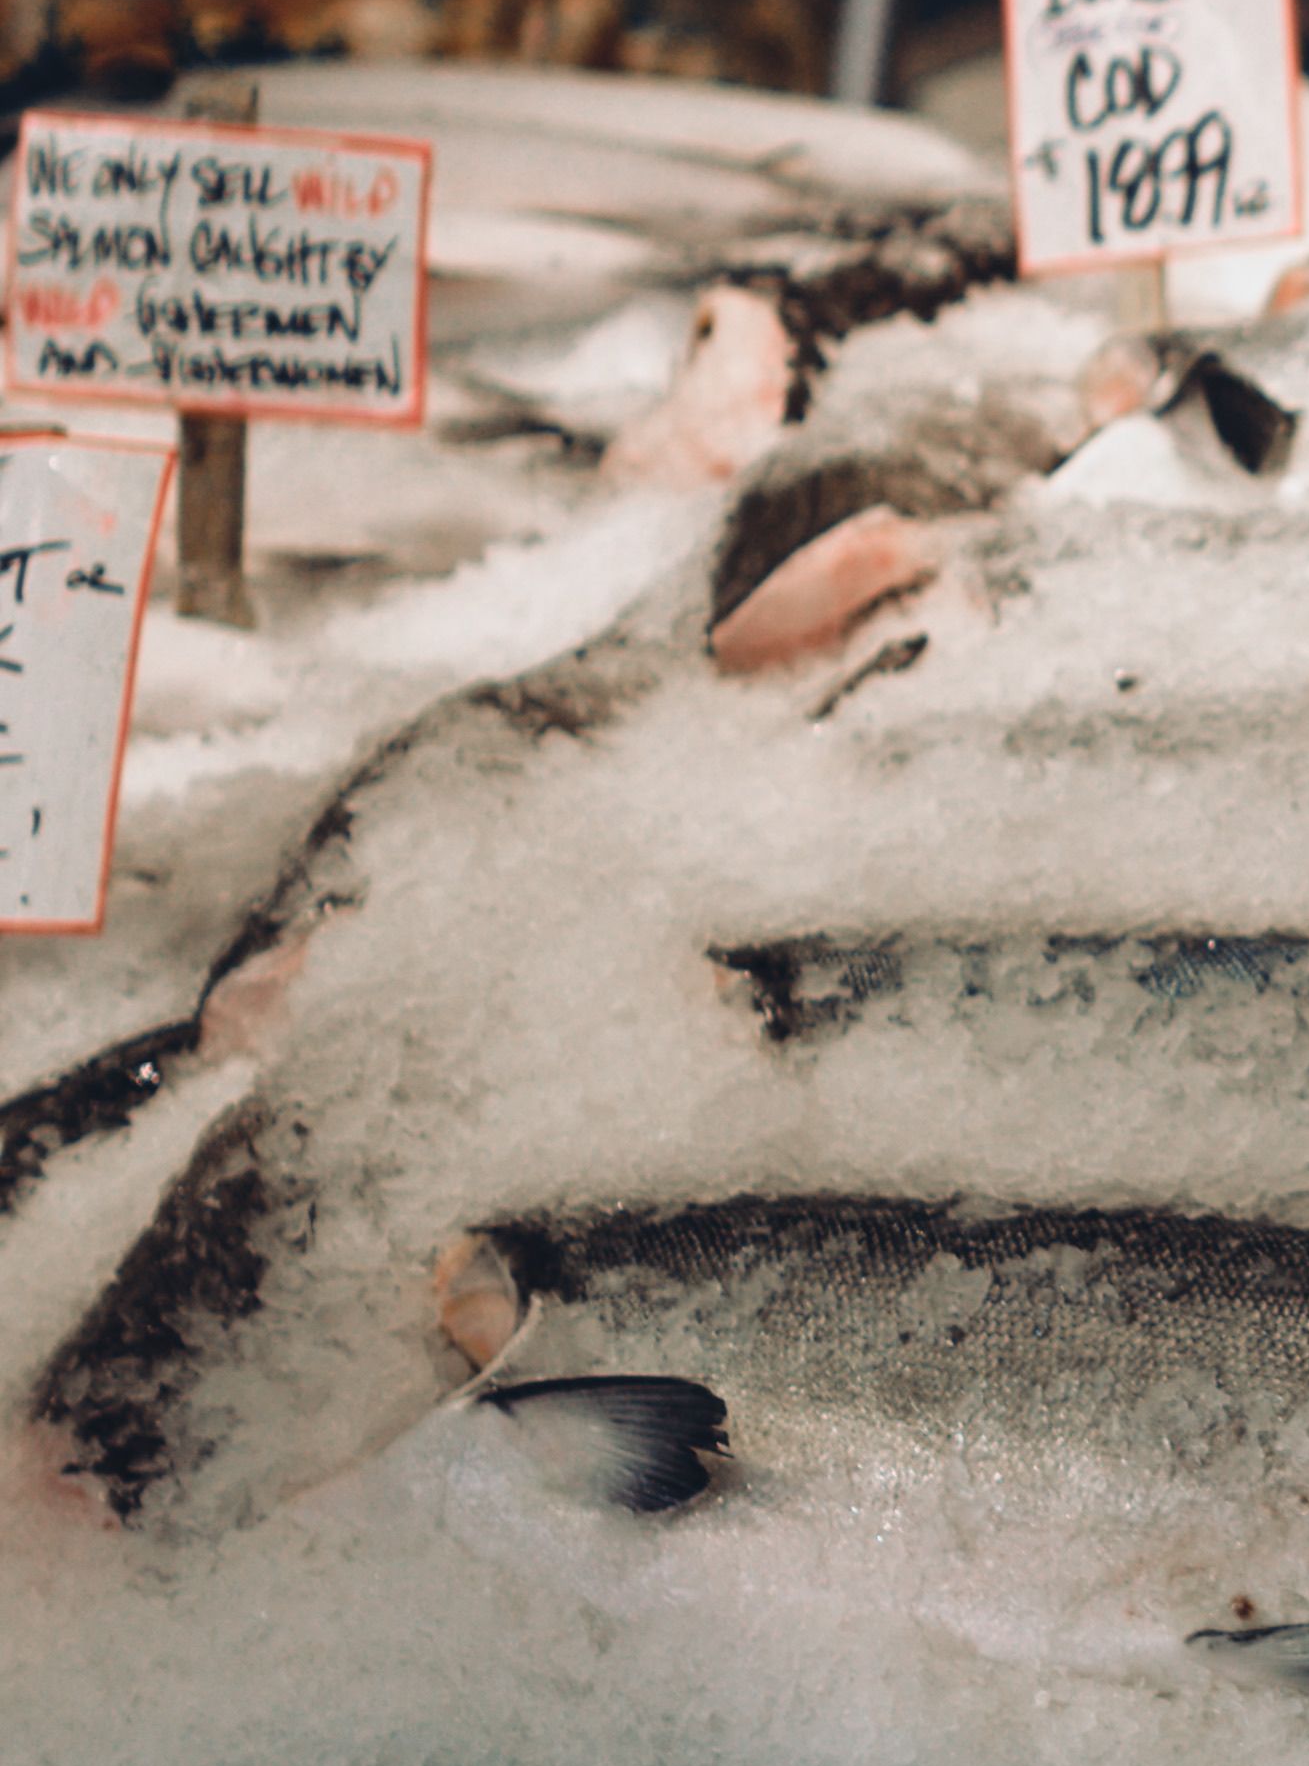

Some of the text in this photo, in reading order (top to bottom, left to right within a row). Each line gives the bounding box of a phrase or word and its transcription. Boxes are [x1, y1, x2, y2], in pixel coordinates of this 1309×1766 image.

[1066, 47, 1183, 131] COD
[26, 132, 88, 196] WE
[93, 140, 181, 210] ONLY
[190, 155, 290, 208] SELL
